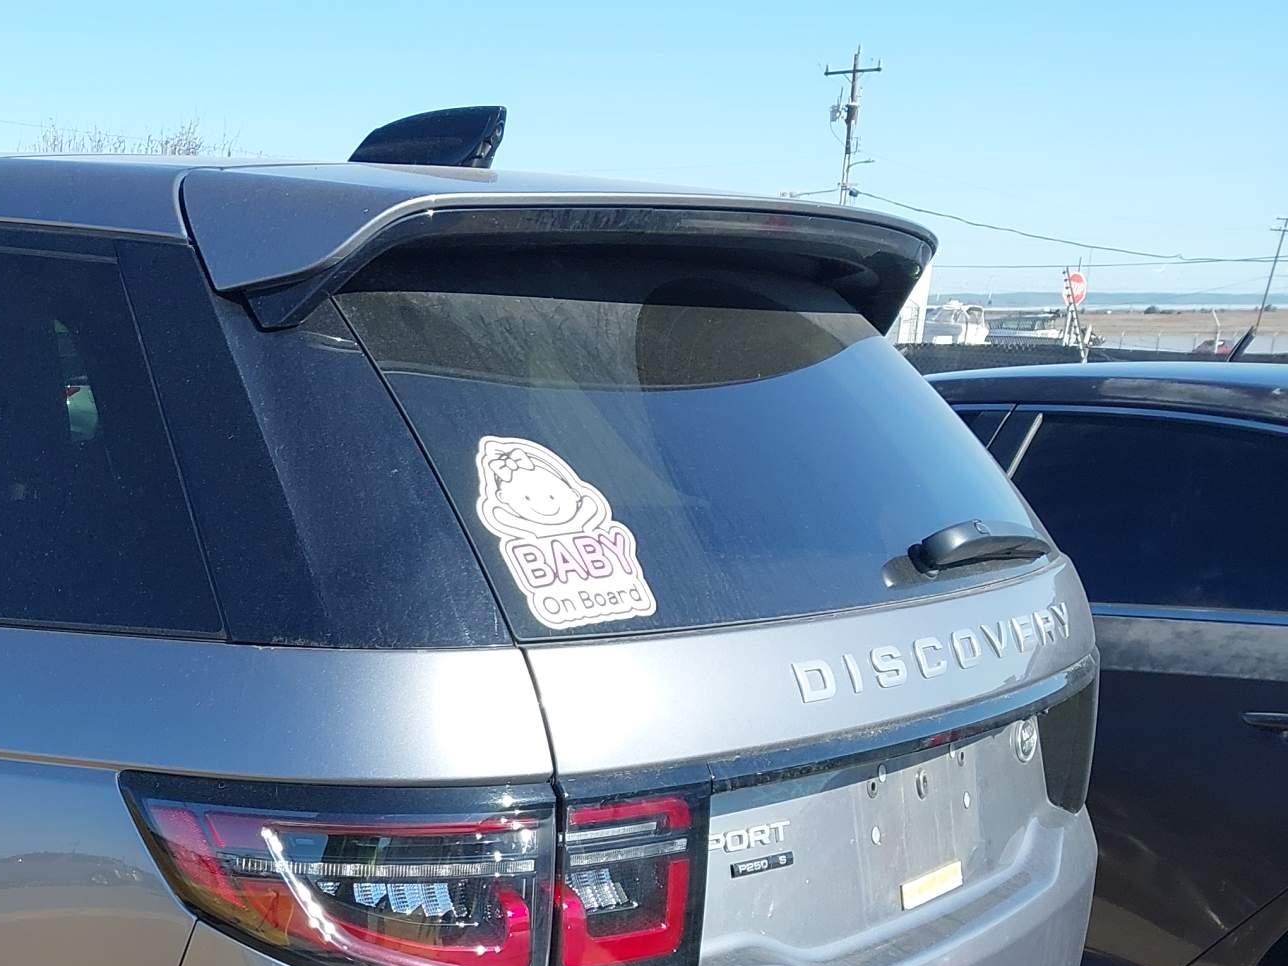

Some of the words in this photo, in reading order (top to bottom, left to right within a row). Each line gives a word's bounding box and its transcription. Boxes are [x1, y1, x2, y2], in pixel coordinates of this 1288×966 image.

[512, 532, 633, 588] BABY
[543, 596, 577, 615] On
[578, 584, 642, 609] Board
[791, 602, 1070, 704] DISCOVERY
[708, 820, 791, 853] PORT
[738, 859, 769, 874] P250
